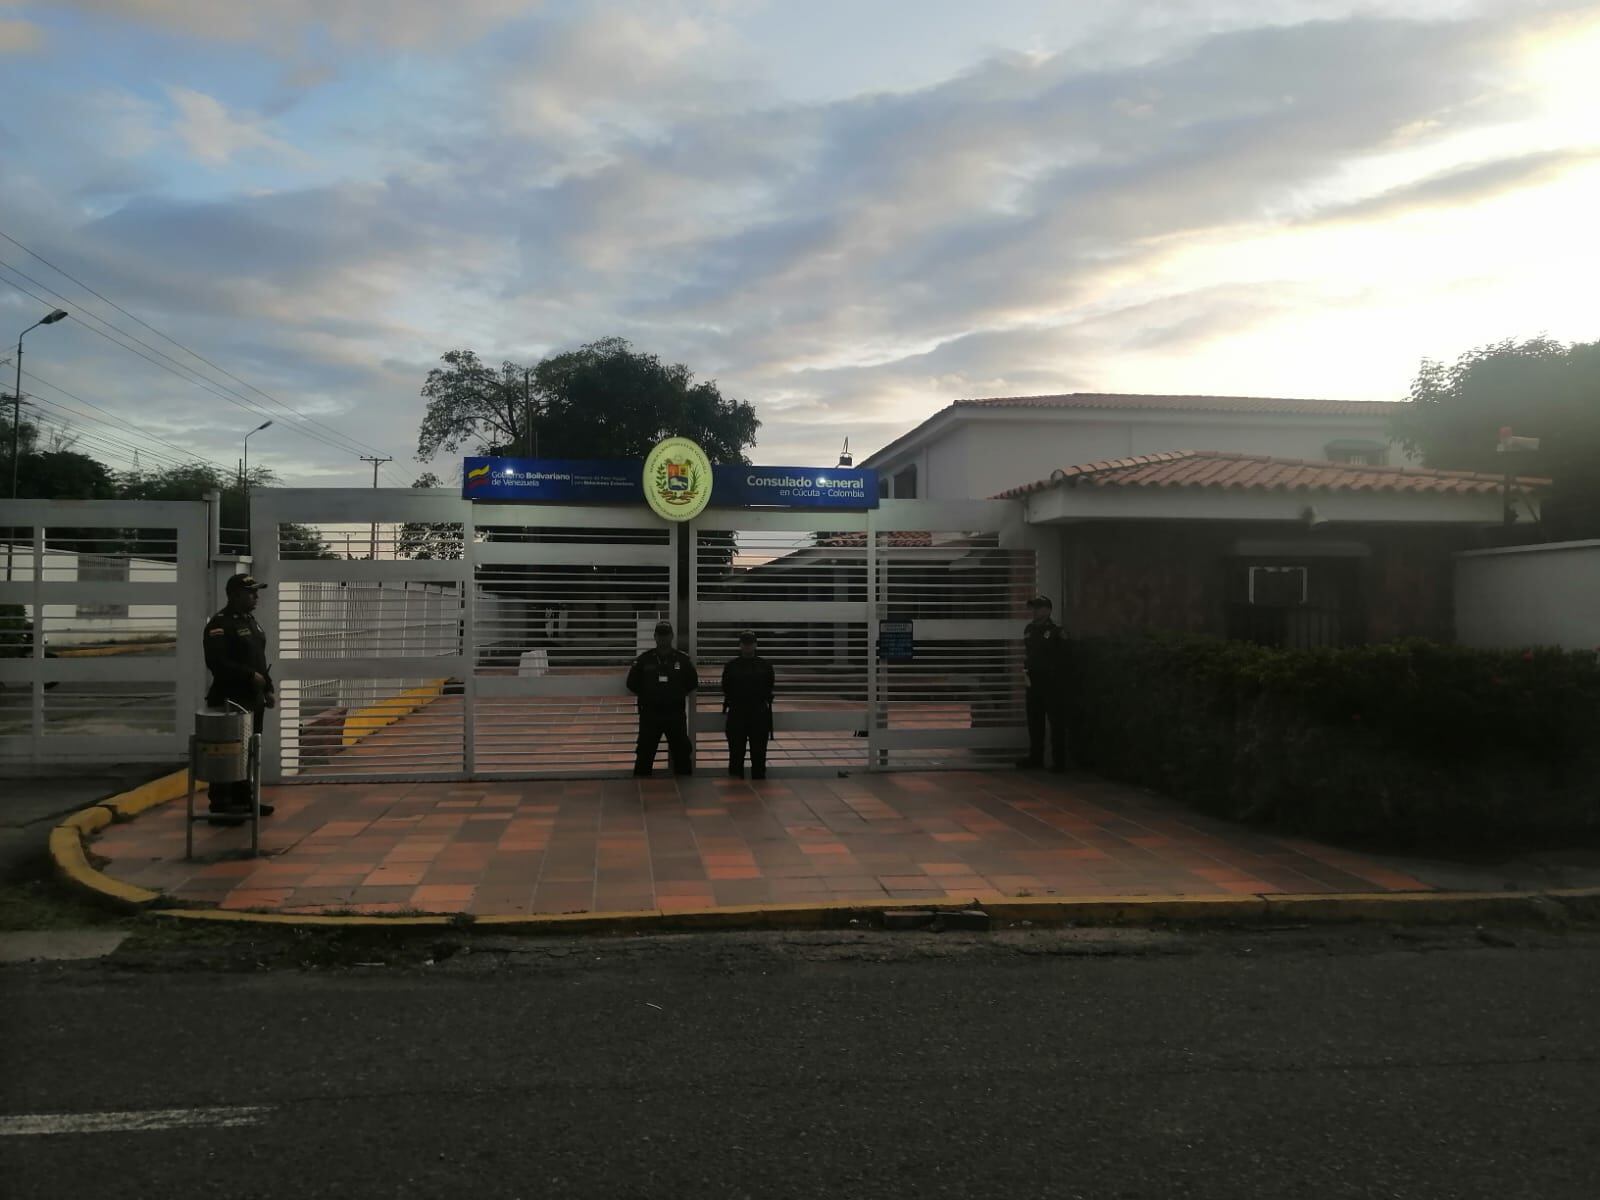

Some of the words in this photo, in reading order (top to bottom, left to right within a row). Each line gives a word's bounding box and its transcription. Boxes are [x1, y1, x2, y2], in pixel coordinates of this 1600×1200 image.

[526, 472, 571, 481] Bolivariano
[491, 478, 502, 486] de
[503, 479, 540, 487] Venezuela
[746, 475, 812, 487] Consulado
[815, 477, 864, 489] General
[792, 488, 820, 497] Cúcuta
[828, 489, 865, 498] Colombia
